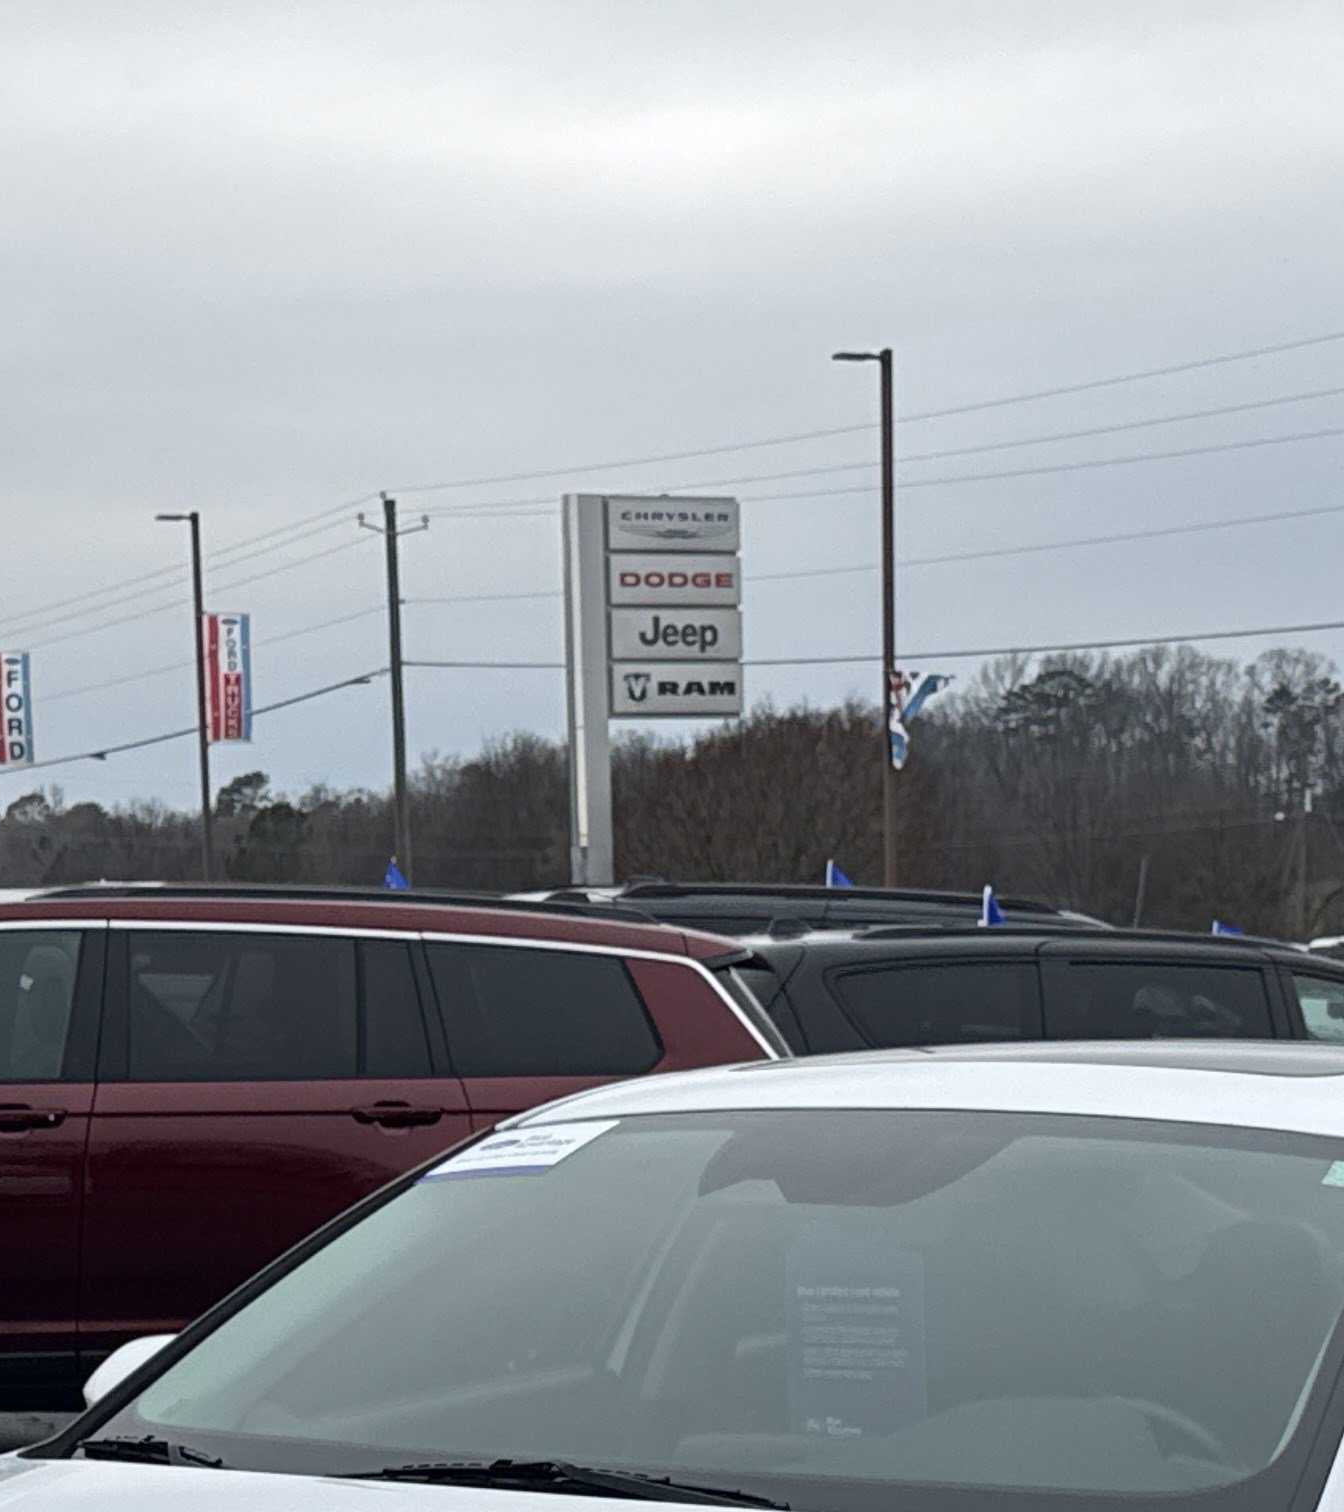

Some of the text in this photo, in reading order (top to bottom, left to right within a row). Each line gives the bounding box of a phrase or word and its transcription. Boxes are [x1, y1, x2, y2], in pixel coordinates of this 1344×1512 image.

[620, 510, 730, 523] CHRYSLER
[619, 571, 735, 589] DODGE
[638, 615, 719, 653] Jeep
[656, 680, 737, 697] RAM
[5, 670, 25, 761] FORD
